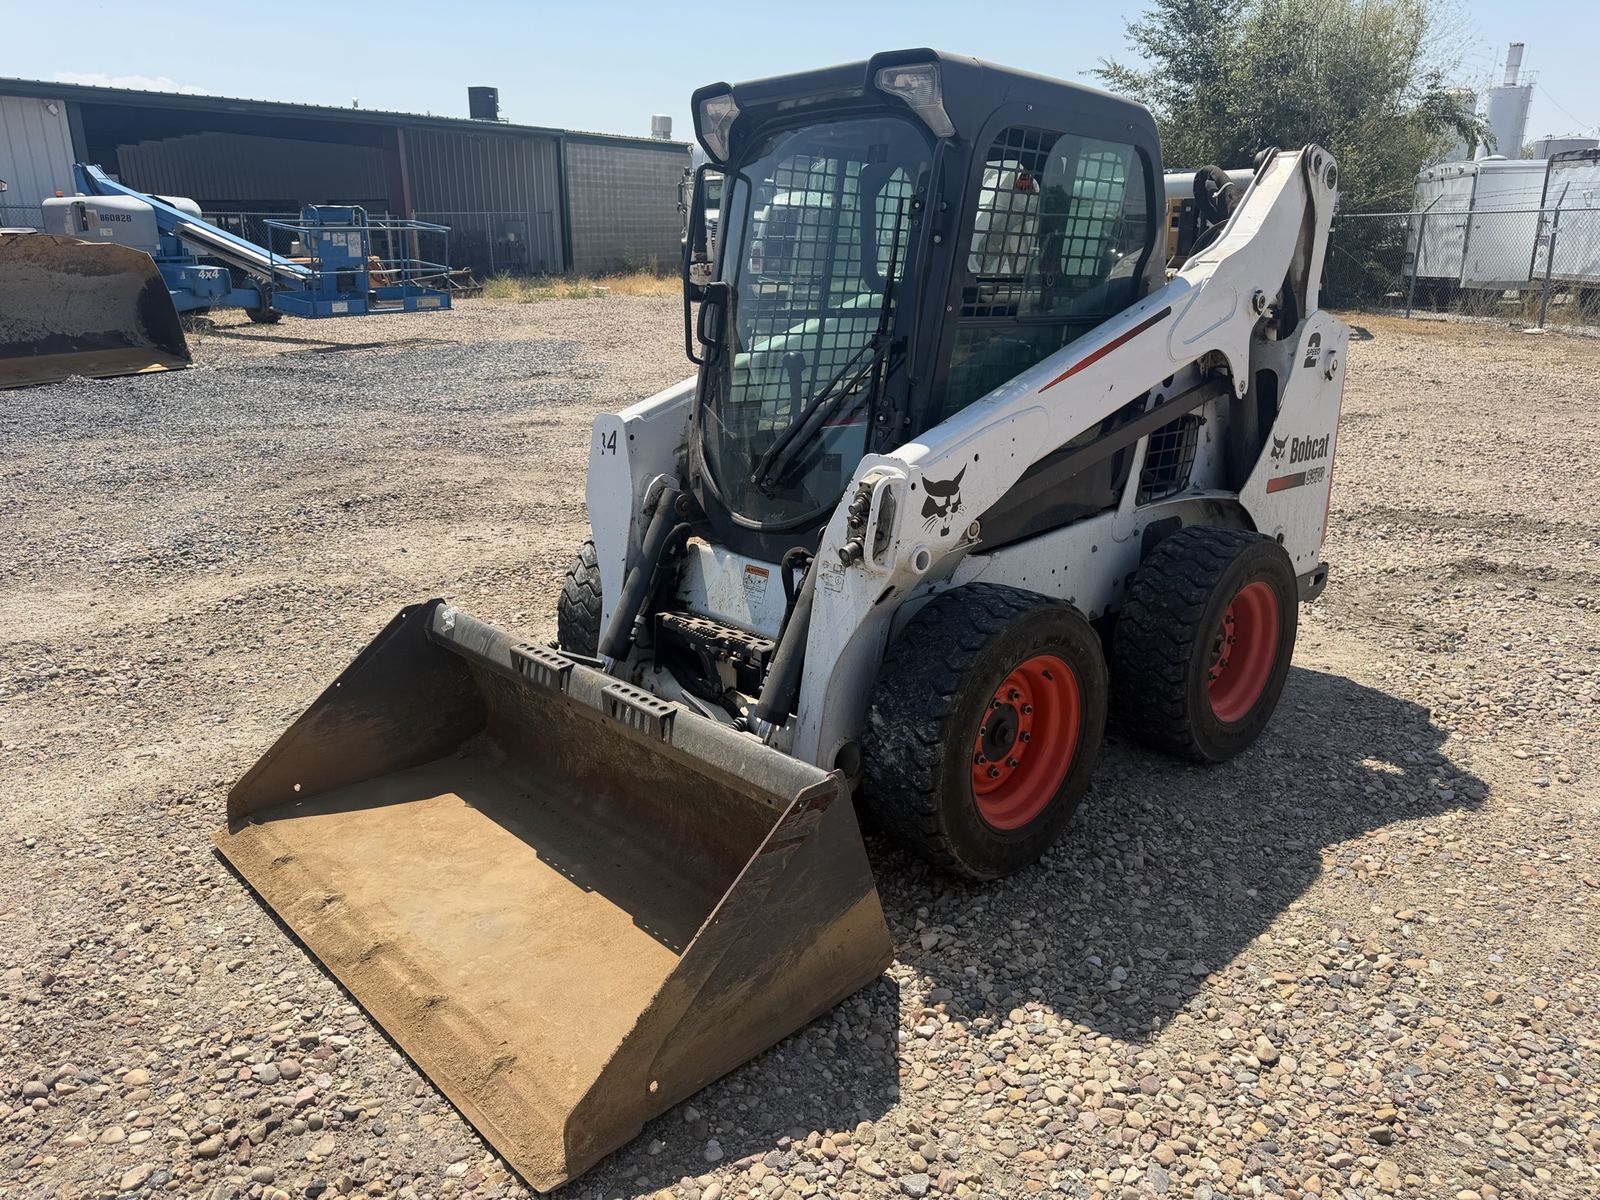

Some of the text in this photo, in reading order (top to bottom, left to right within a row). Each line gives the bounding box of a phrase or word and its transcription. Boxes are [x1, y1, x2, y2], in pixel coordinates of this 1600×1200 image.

[198, 269, 219, 279] 4x4
[1303, 332, 1321, 368] 2
[1305, 347, 1321, 356] SPEED
[1289, 432, 1330, 464] Bobcat
